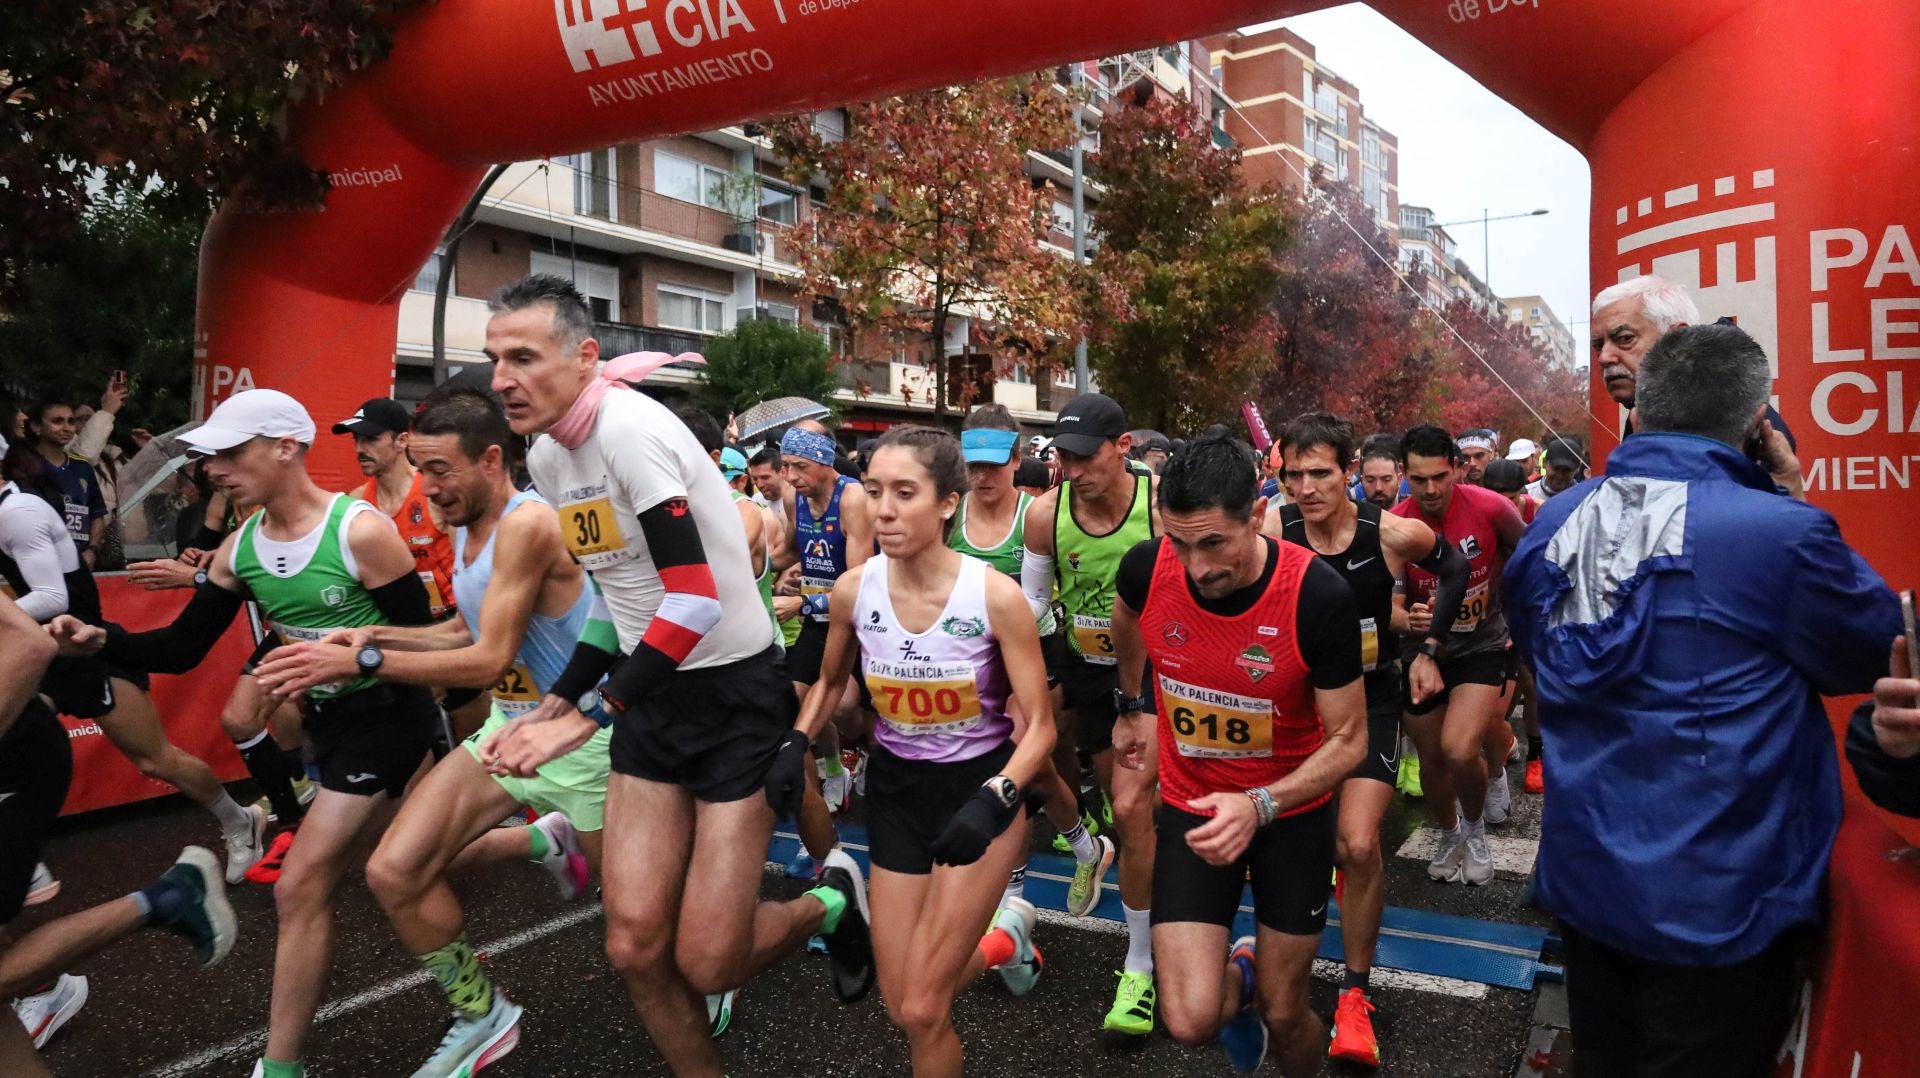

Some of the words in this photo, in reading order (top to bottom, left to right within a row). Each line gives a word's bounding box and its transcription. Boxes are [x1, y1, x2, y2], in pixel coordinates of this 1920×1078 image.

[665, 0, 755, 48] CIA
[588, 48, 774, 108] AYUNTAMIENTO
[1811, 297, 1920, 363] LE
[212, 365, 256, 396] PA
[66, 513, 82, 531] 25
[573, 509, 600, 546] 30
[863, 623, 888, 633] VIATOR
[870, 660, 892, 676] 3x7K
[894, 666, 944, 679] PALENCIA
[880, 685, 961, 717] 700
[1162, 679, 1186, 696] 3x7K
[1188, 688, 1240, 708] PALENCIA
[1173, 706, 1251, 745] 618
